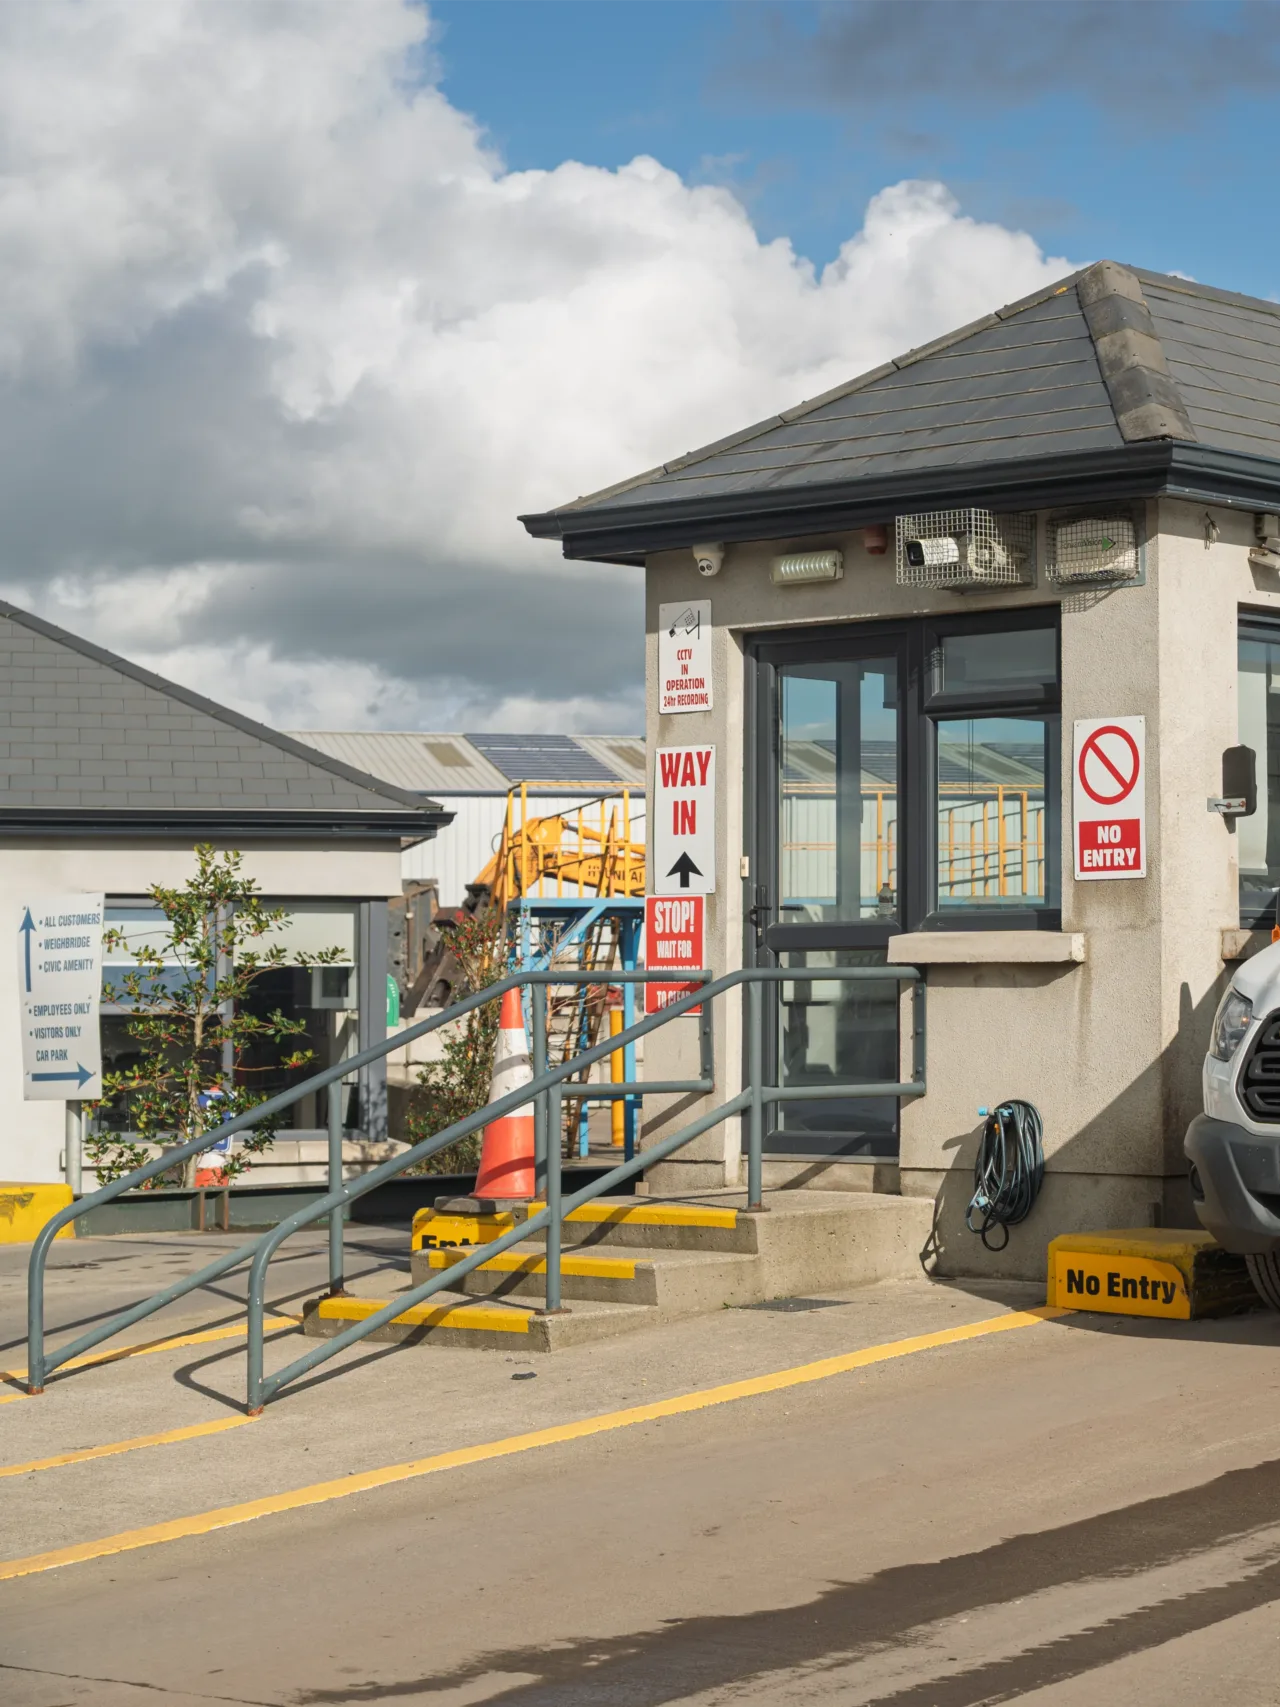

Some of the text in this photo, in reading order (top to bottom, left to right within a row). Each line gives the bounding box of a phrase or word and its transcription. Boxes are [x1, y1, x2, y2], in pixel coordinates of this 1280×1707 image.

[677, 648, 692, 661] CCTV
[681, 664, 689, 675] IN
[666, 677, 705, 691] OPERATION
[663, 693, 709, 707] 24hr RECORDING
[660, 750, 711, 788] WAY
[673, 799, 696, 836] IN
[1097, 824, 1122, 844] NO
[1083, 847, 1137, 868] ENTRY
[44, 912, 101, 927] ALL CUSTOMERS
[654, 900, 695, 934] STOP!
[44, 936, 91, 950] WEIGHBRIDGE
[656, 940, 692, 958] WAIT FOR
[43, 958, 94, 973] CIVIC AMENITY
[656, 990, 667, 1009] TO
[33, 1002, 91, 1017] EMPLOYEES ONLY
[34, 1025, 82, 1039] VISITORS ONLY
[36, 1048, 68, 1062] CAR PARK
[1067, 1268, 1176, 1304] No Entry
